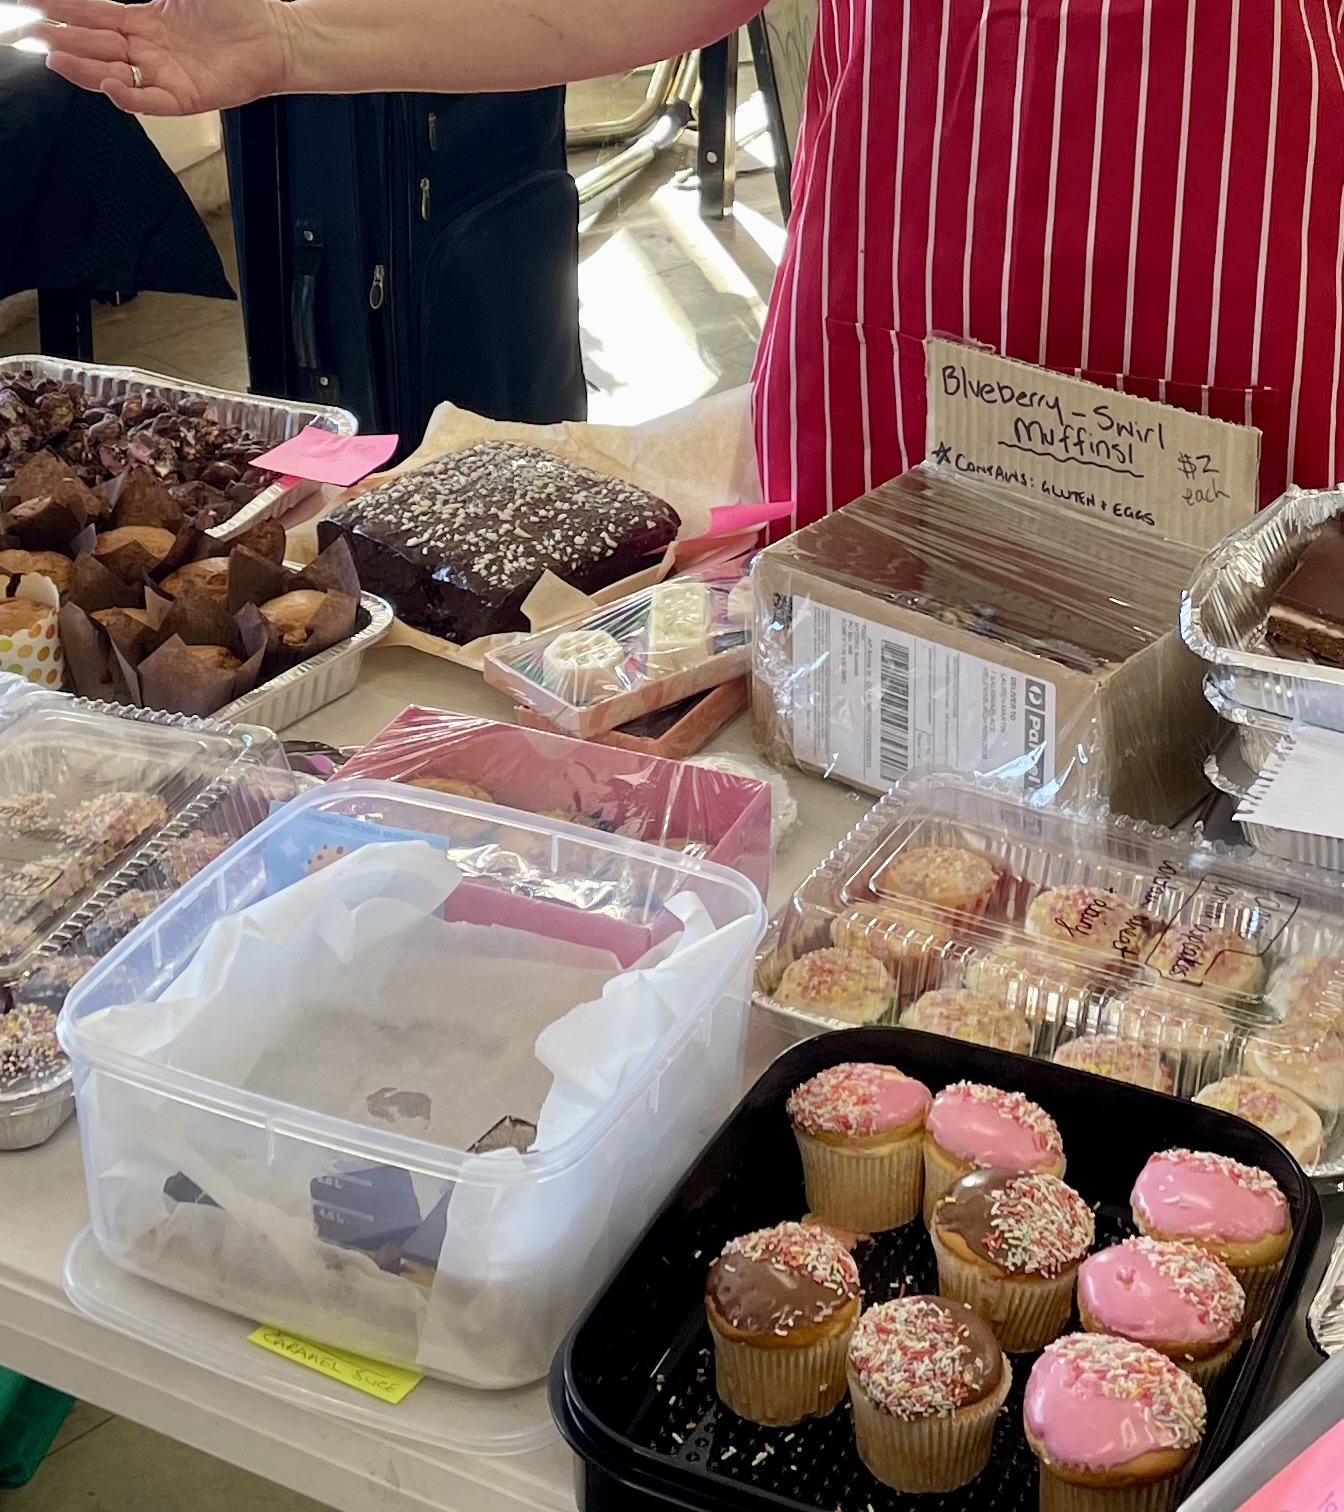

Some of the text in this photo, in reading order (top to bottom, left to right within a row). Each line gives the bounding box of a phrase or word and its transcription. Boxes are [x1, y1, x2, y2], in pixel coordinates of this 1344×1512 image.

[941, 364, 1065, 425] Blueberry
[1092, 405, 1166, 450] Swirl
[1176, 452, 1220, 481] $2
[1041, 480, 1096, 508] GLUTEN
[1112, 502, 1156, 526] EGGS
[1181, 478, 1231, 507] each
[263, 1331, 401, 1393] CARAMEL SLICE
